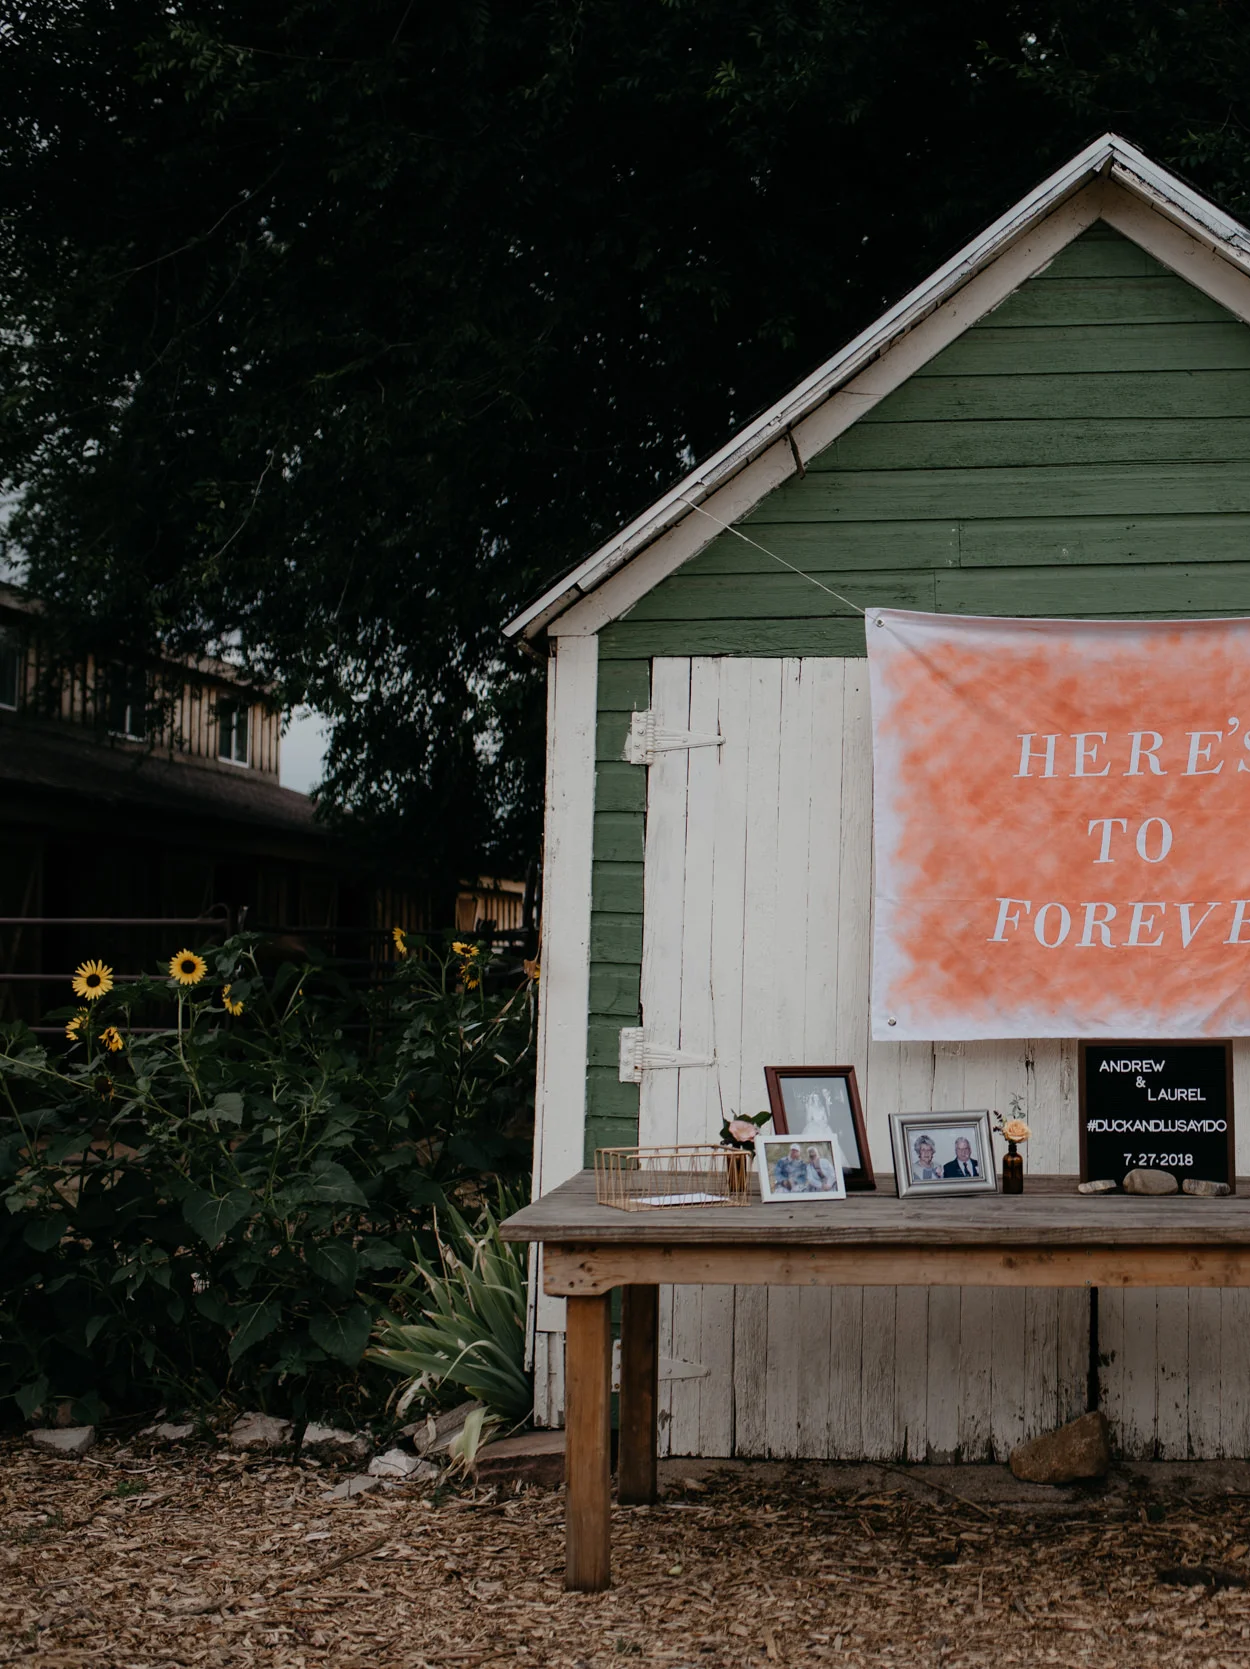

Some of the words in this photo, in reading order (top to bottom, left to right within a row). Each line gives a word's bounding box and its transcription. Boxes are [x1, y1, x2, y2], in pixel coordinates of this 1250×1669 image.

[1088, 817, 1173, 863] TO
[1099, 1059, 1166, 1073] ANDREW
[1135, 1076, 1146, 1088] &
[1147, 1088, 1207, 1101] LAUREL
[1086, 1118, 1228, 1133] #DUCKANDLUSAYIDO
